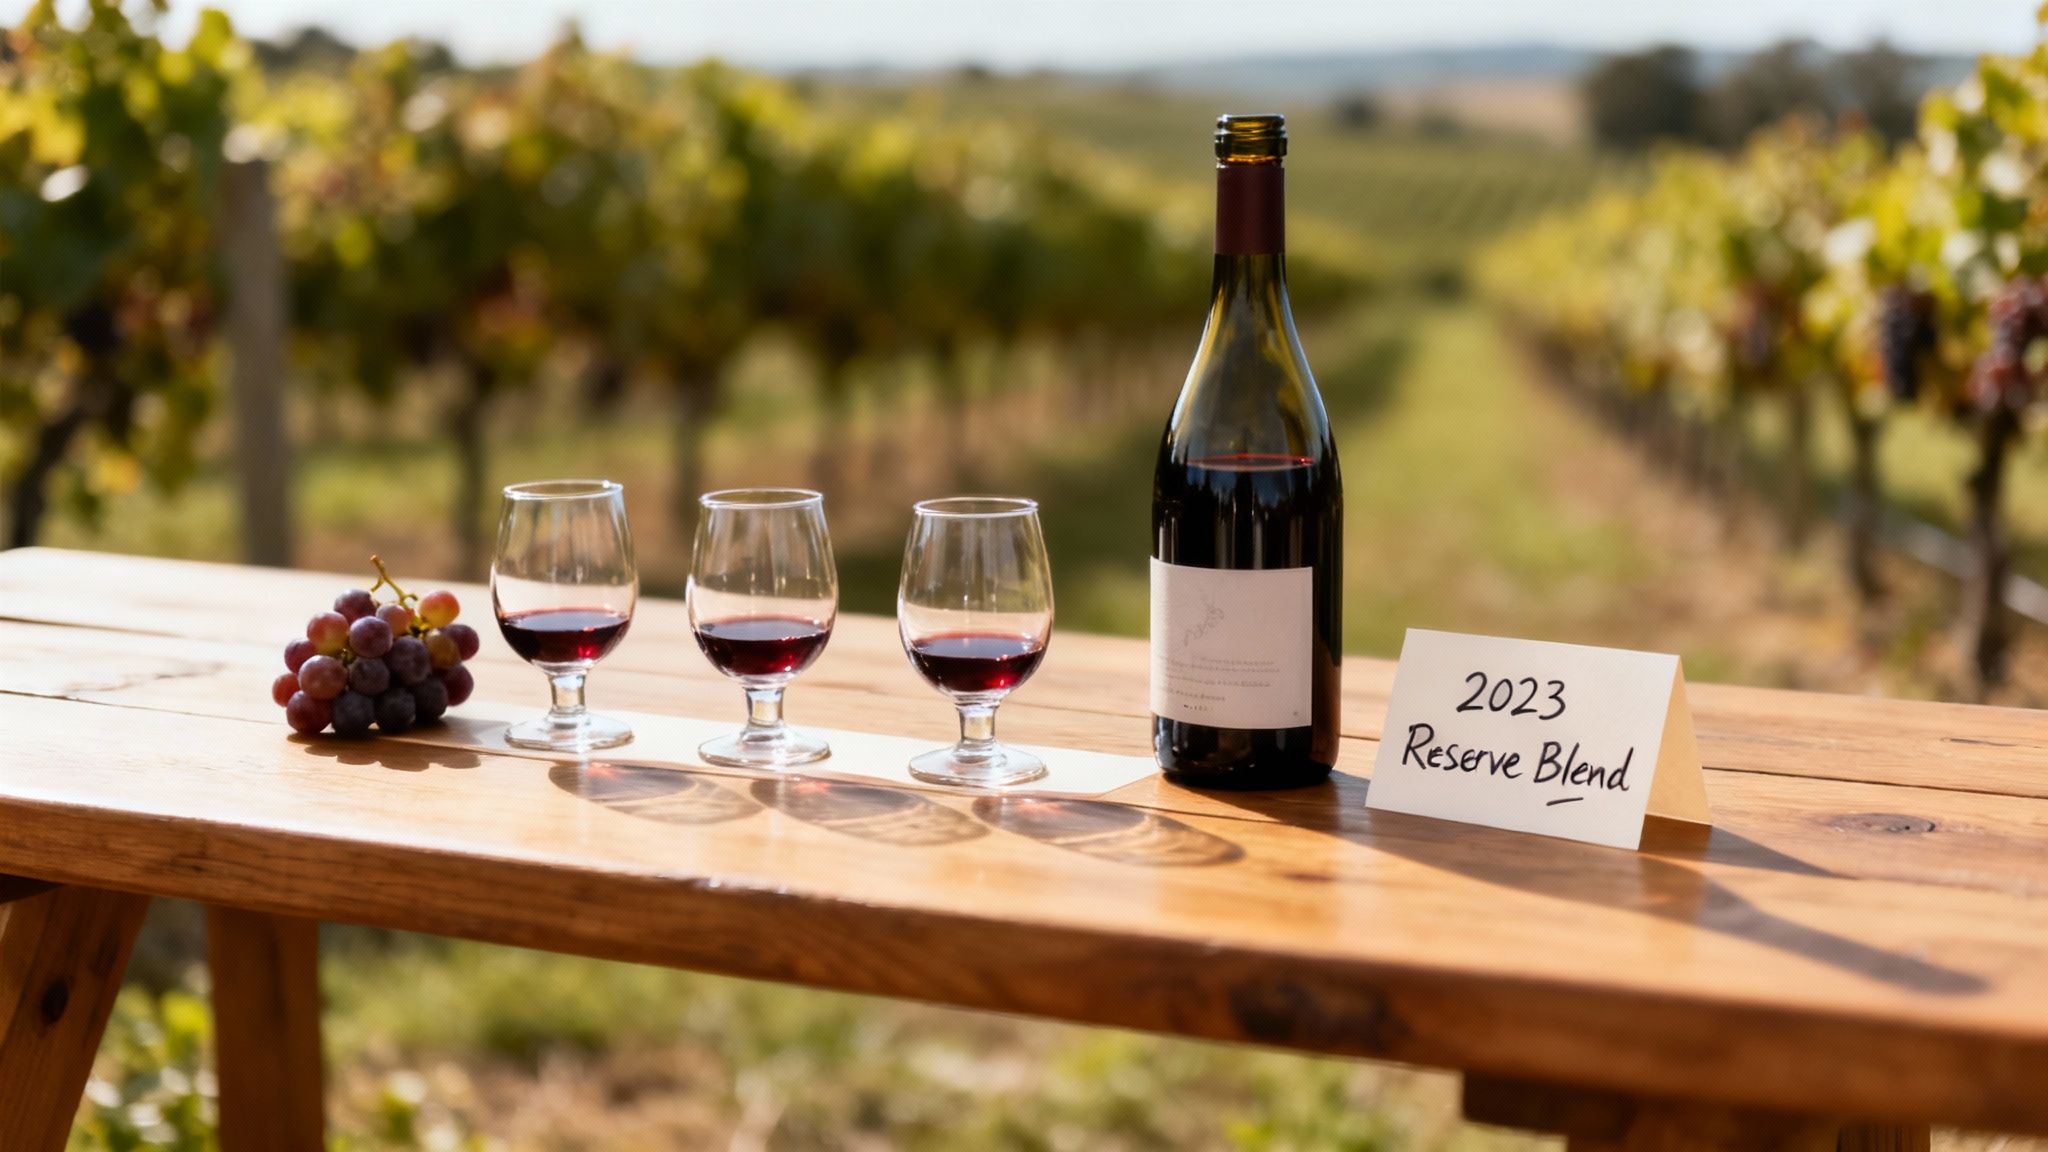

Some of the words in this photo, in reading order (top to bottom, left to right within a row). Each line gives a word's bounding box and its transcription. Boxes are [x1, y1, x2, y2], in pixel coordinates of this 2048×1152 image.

[1456, 671, 1566, 721] 2023
[1402, 722, 1522, 779] Reserve
[1533, 741, 1634, 791] Blend
